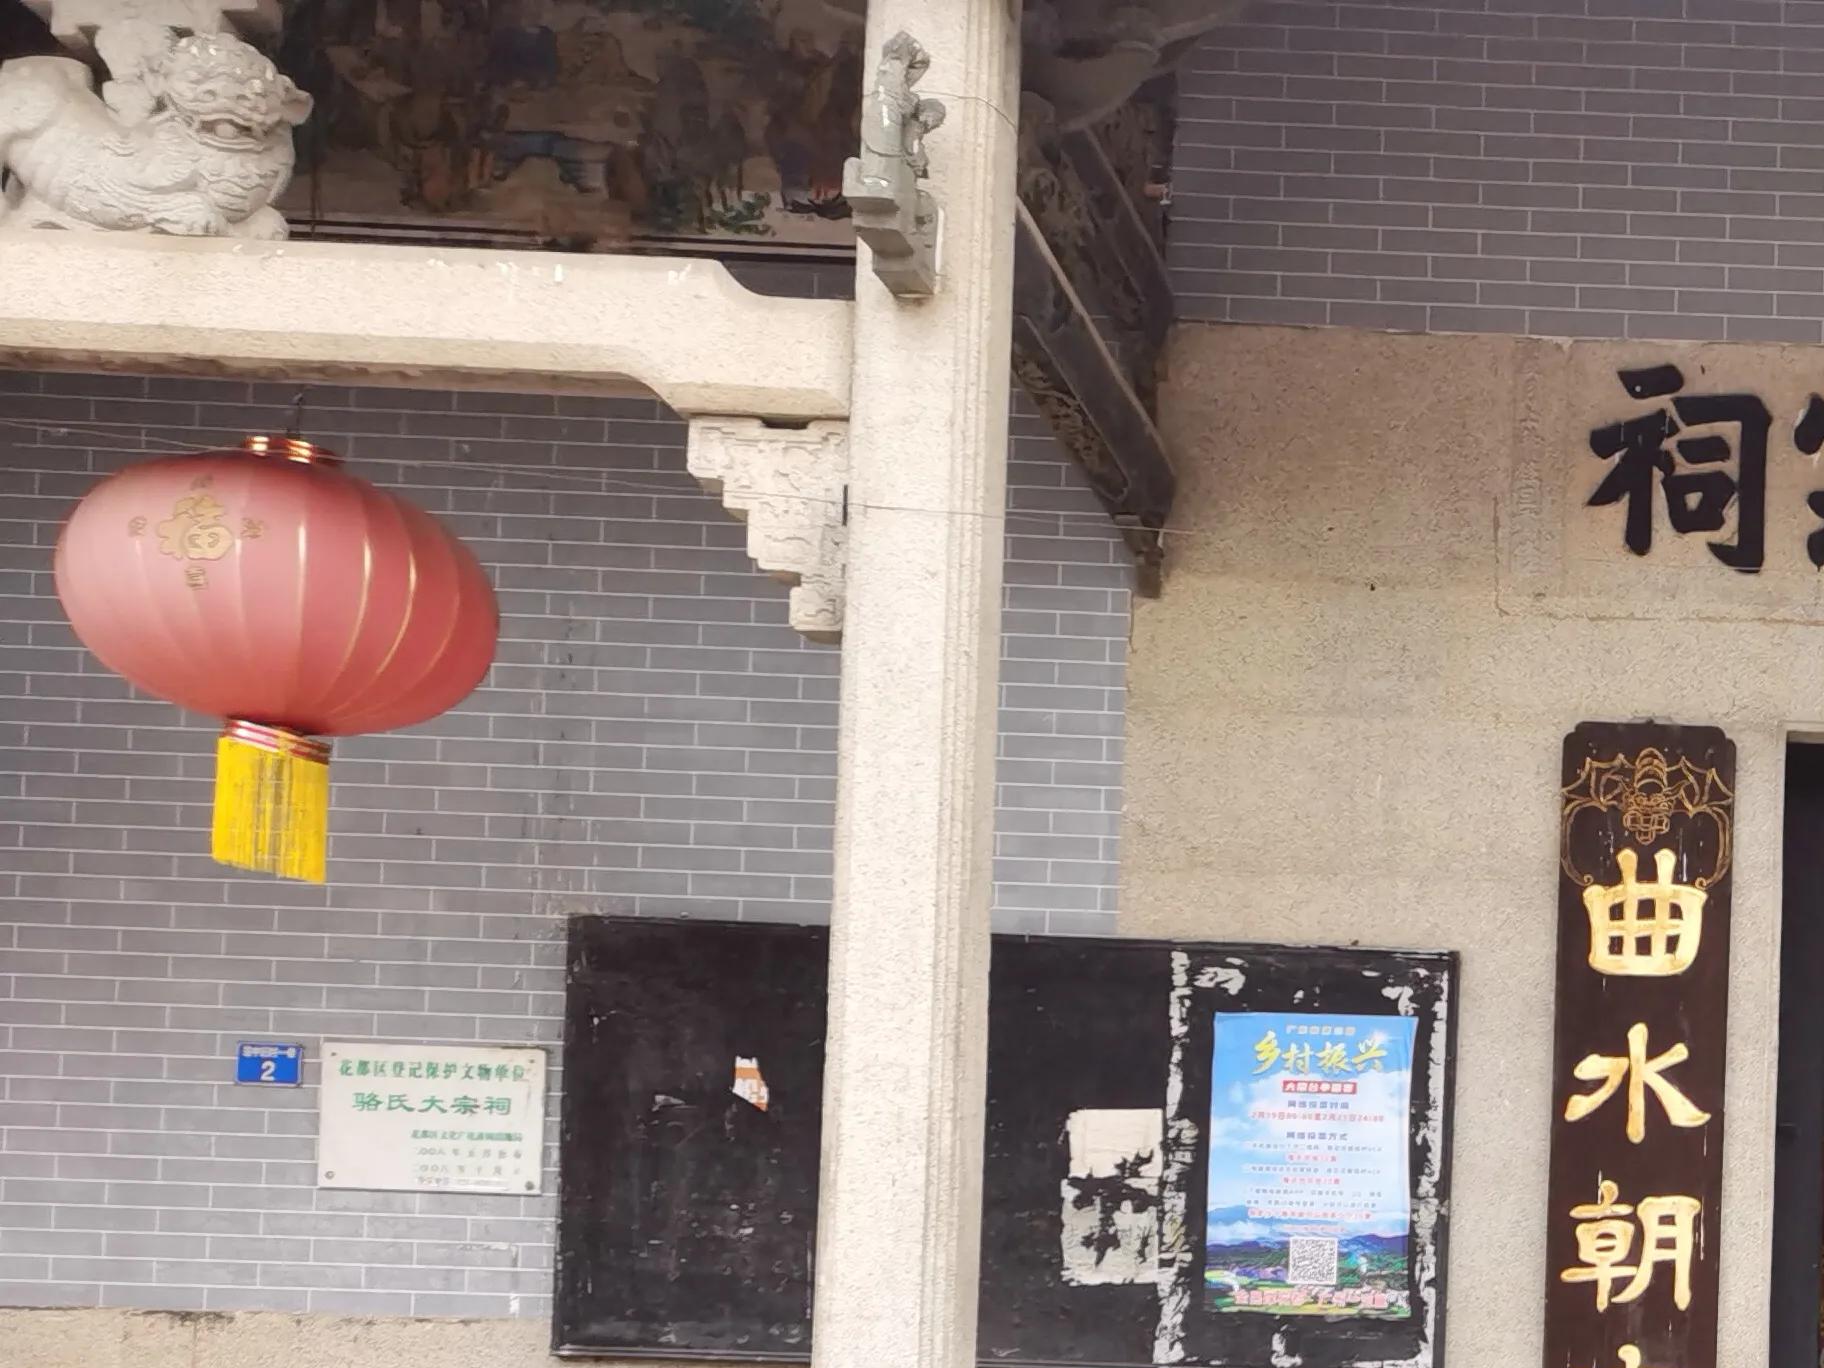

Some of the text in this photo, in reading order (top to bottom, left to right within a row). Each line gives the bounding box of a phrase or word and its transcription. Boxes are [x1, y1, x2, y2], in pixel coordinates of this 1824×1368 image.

[1252, 1030, 1388, 1076] 乡村振兴
[261, 1060, 276, 1081] 2
[339, 1059, 526, 1082] 花都区登记保护文物单位
[351, 1092, 513, 1116] 骆氏大宗祠
